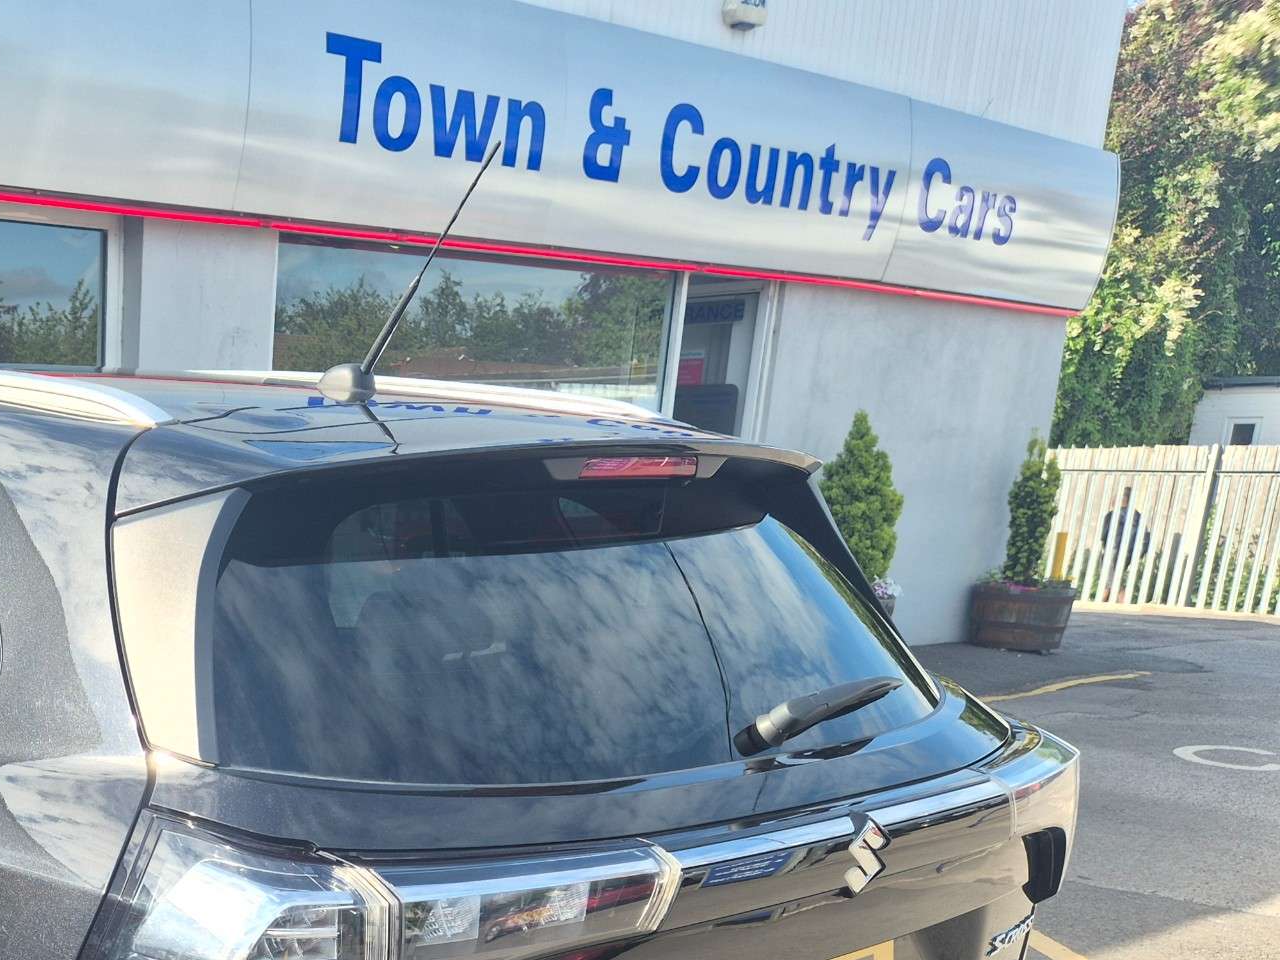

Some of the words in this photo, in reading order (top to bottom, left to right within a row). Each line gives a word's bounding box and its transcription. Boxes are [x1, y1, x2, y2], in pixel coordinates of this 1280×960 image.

[326, 31, 546, 172] Town
[582, 87, 631, 183] &
[660, 103, 897, 242] Country
[919, 158, 1017, 246] Cars
